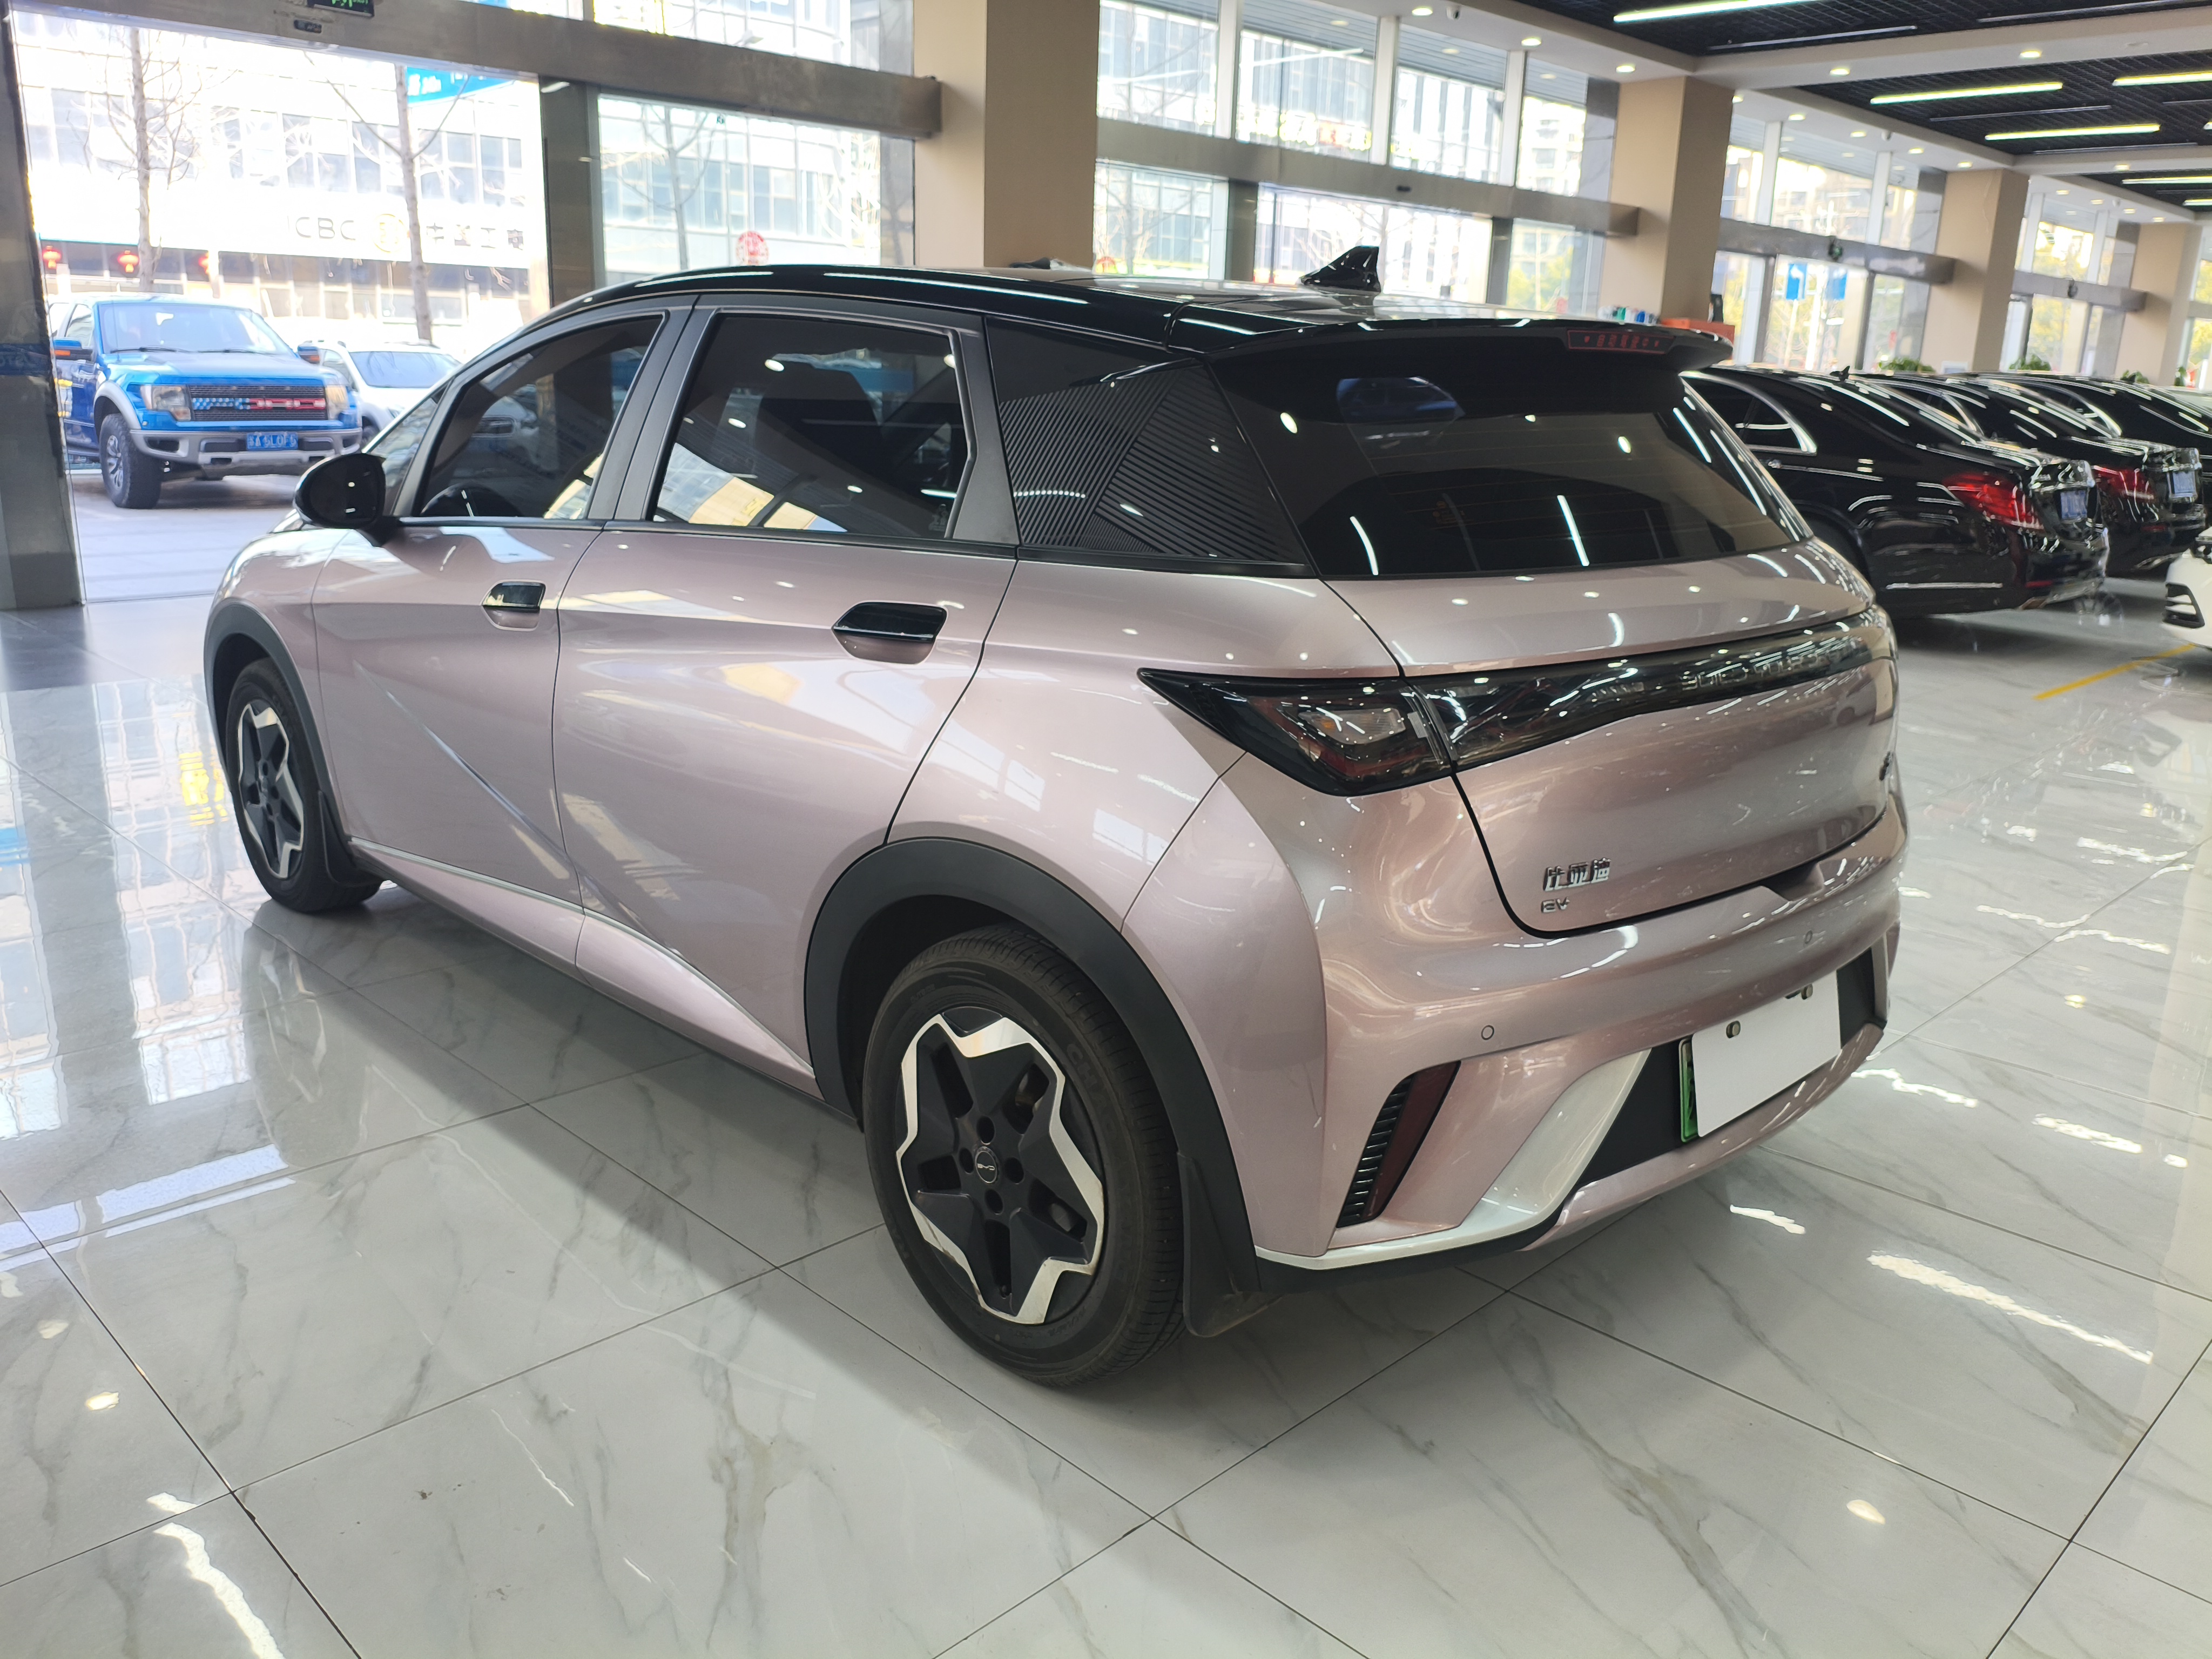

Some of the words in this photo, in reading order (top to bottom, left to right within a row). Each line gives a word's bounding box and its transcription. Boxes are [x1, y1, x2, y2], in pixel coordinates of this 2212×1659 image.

[1543, 857, 1611, 891] 比亚迪
[1541, 897, 1570, 913] EV
[977, 1163, 995, 1171] BYD
